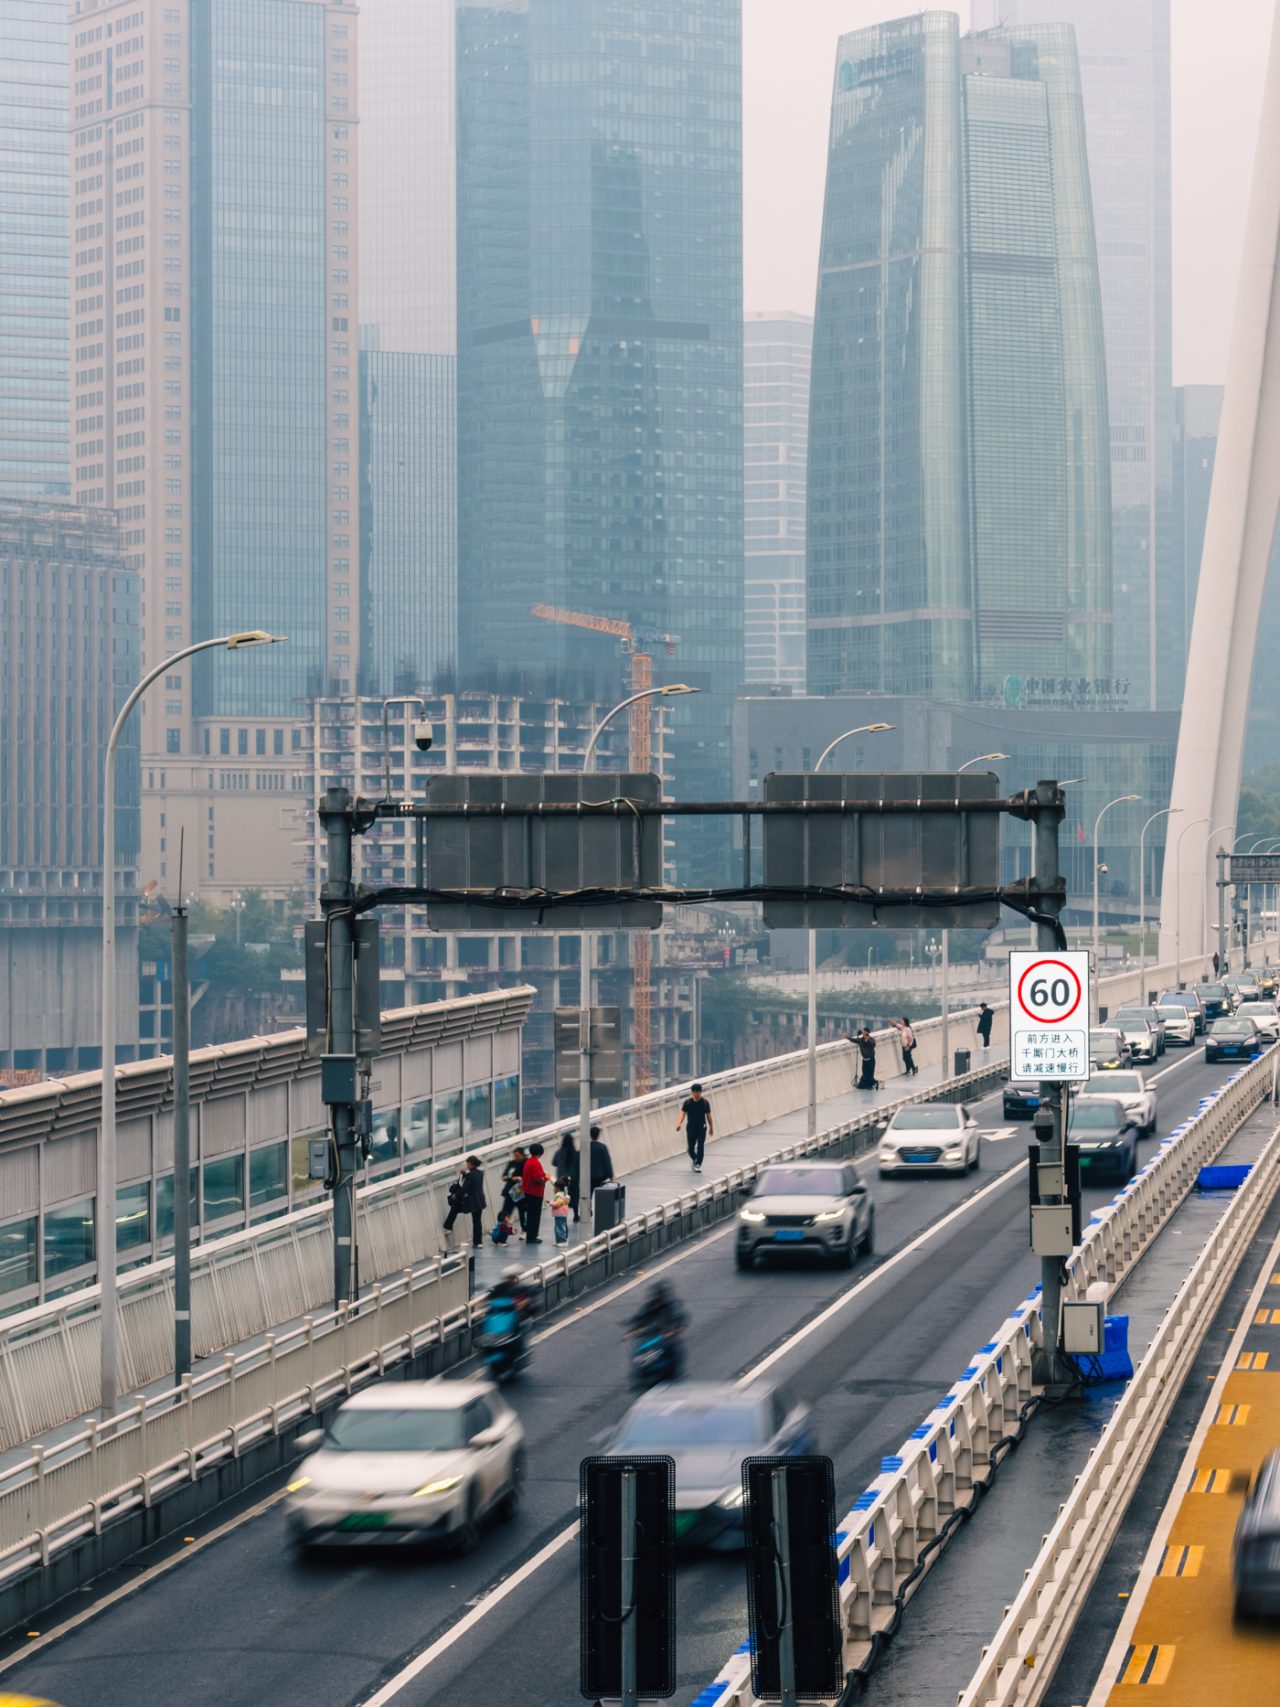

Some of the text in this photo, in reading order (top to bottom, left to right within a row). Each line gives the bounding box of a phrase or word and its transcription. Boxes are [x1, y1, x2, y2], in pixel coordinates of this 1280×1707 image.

[1026, 677, 1129, 695] 中国农业银行
[1030, 978, 1070, 1007] 60
[1027, 1033, 1073, 1045] 前方进入
[1022, 1047, 1079, 1059] 千厮门大桥
[1022, 1062, 1079, 1073] 请减速慢行
